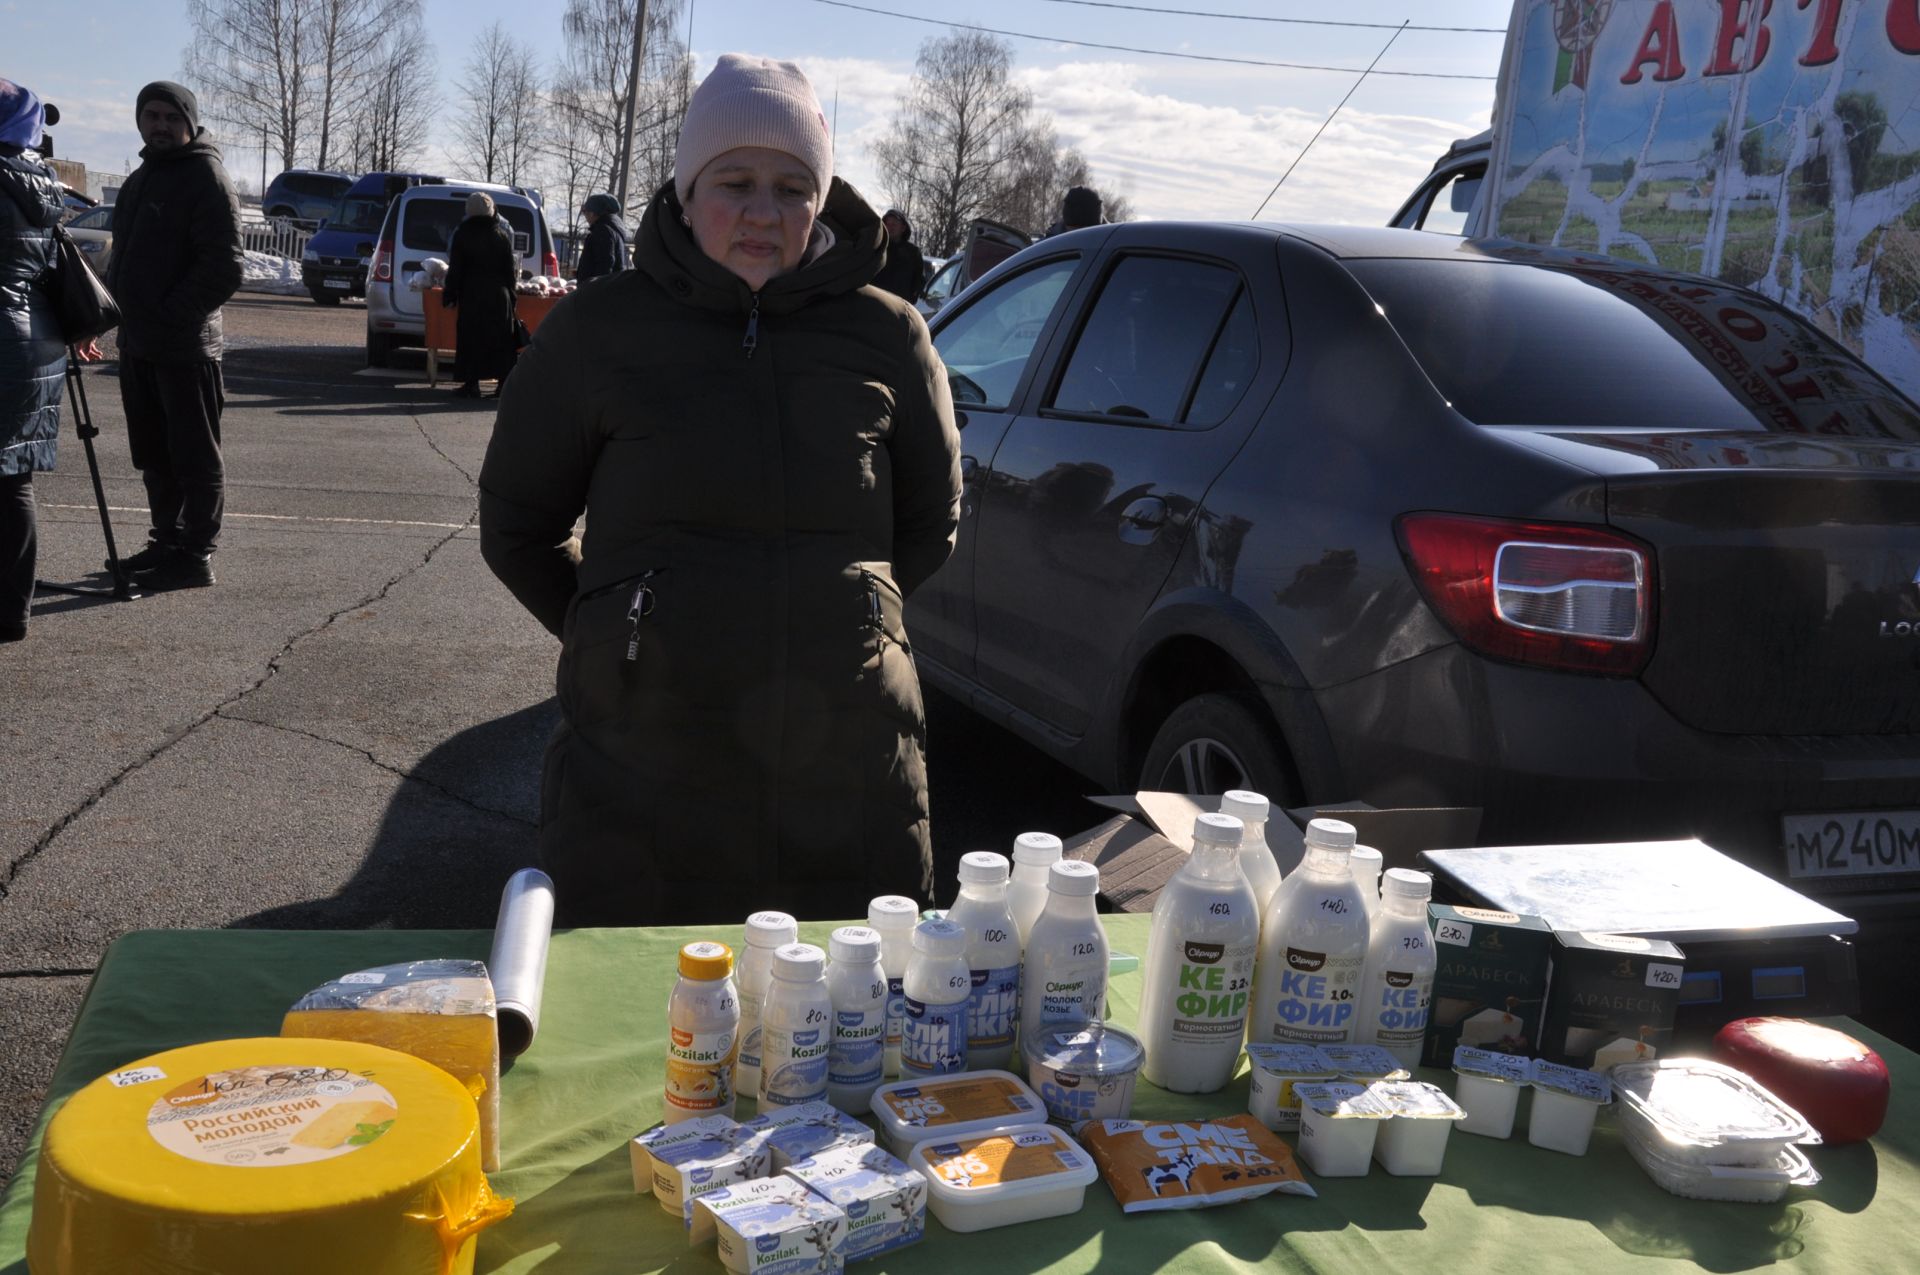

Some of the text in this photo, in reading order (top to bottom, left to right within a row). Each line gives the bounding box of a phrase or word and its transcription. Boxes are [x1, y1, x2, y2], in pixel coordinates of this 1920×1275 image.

[1179, 963, 1226, 992] КЕ
[1280, 969, 1328, 1000] КЕ
[1176, 991, 1248, 1018] ФИР
[1381, 987, 1418, 1008] КЕ
[1277, 998, 1353, 1027] ФИР
[670, 1041, 719, 1061] Kozilakt
[1142, 1123, 1259, 1150] СМЕ
[1156, 1145, 1275, 1166] ТАНА
[689, 1177, 730, 1195] Kozilakt
[847, 1211, 887, 1231] Kozilakt
[755, 1246, 800, 1266] Kozilakt
